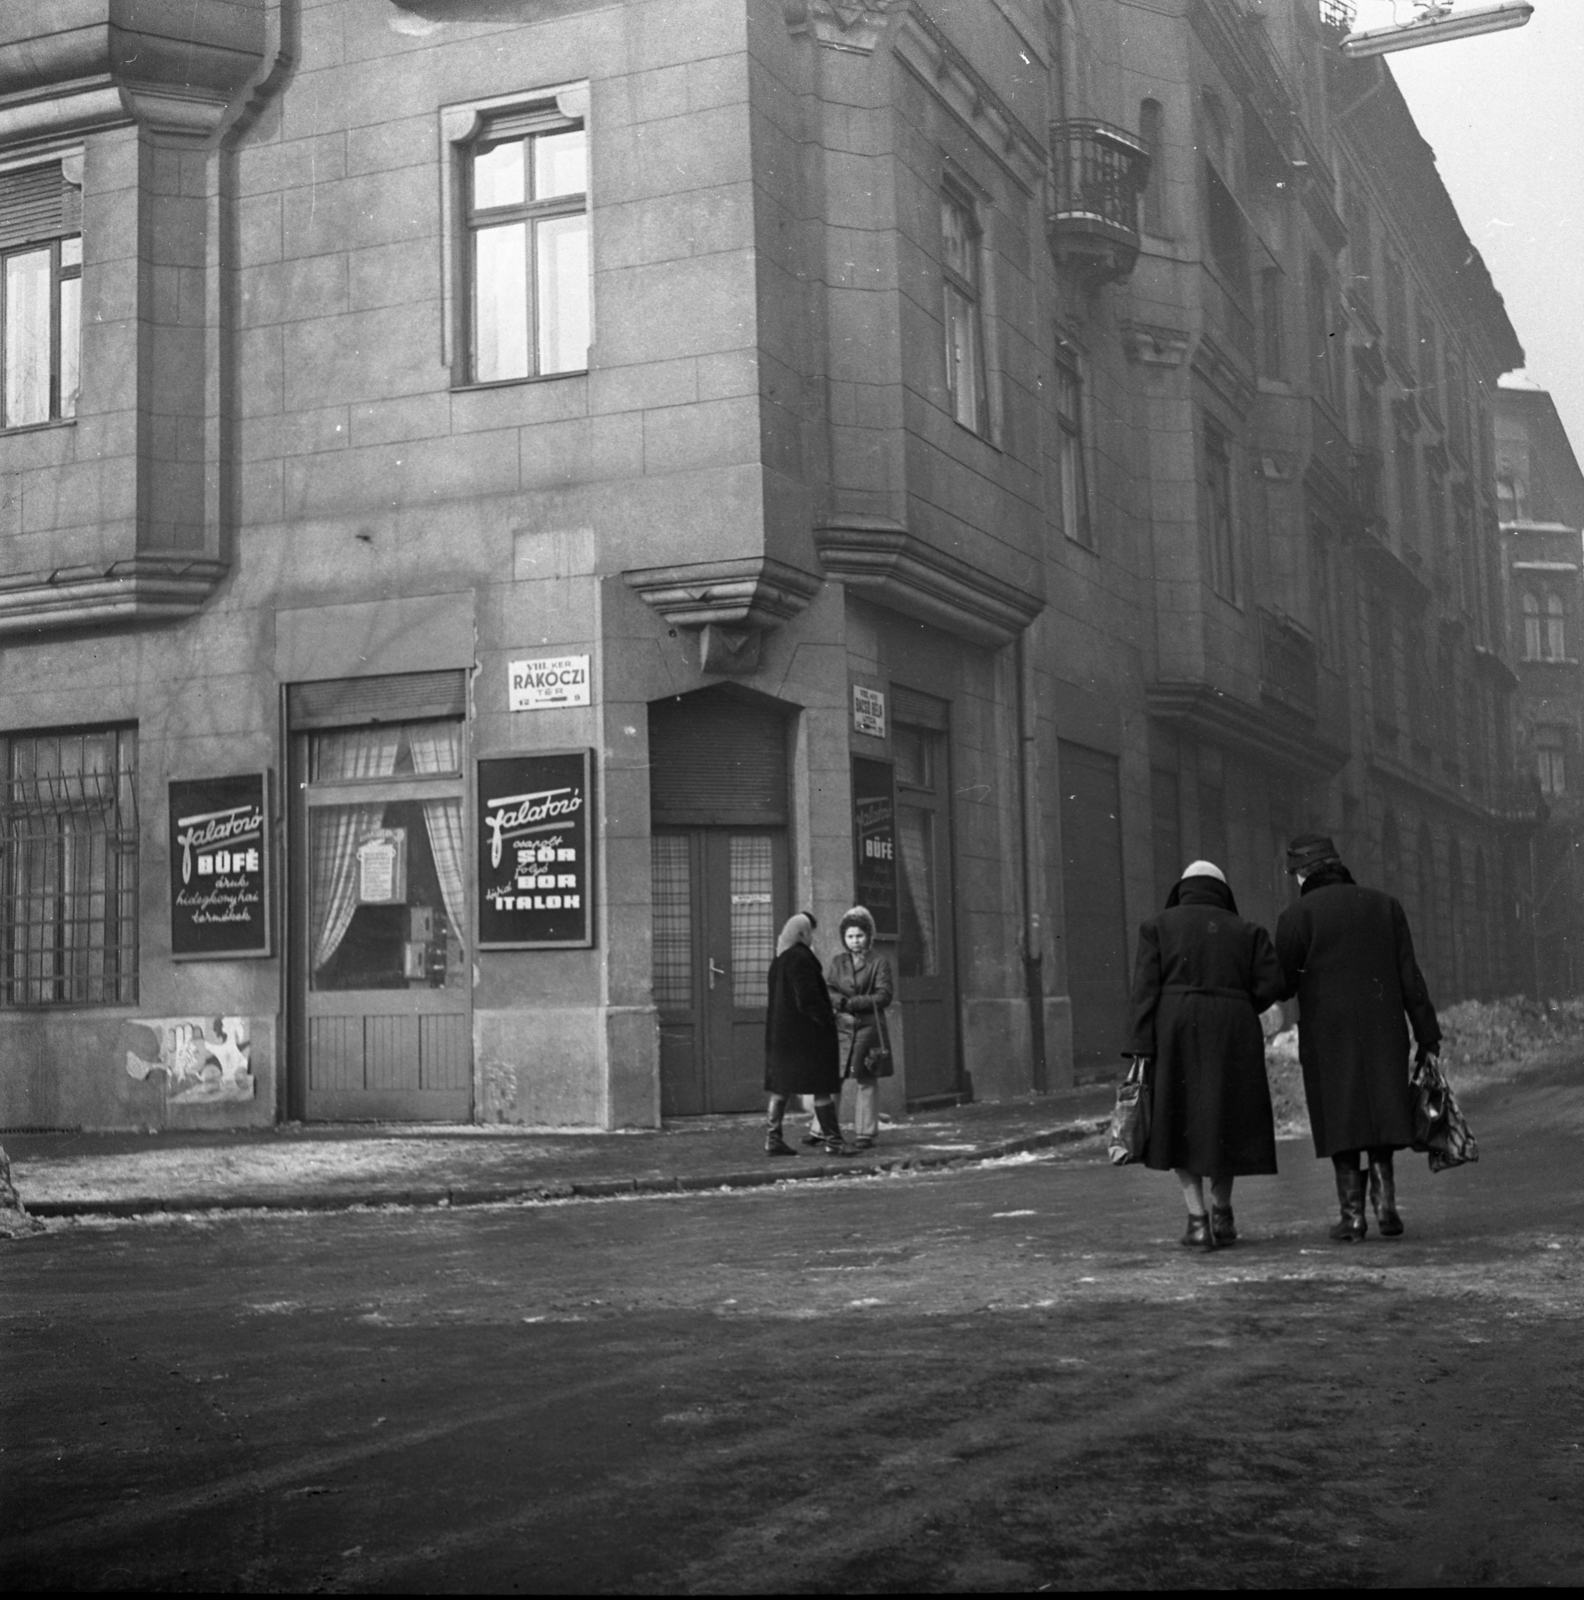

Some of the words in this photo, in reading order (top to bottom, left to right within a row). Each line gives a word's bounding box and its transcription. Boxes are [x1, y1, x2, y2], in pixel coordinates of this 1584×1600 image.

[514, 669, 585, 690] RÁKÓCZI
[537, 687, 563, 696] TÉR
[517, 845, 576, 863] SÖR
[865, 836, 893, 860] BÜFÉ
[198, 848, 259, 875] BÜFÉ
[514, 861, 549, 880] folyó
[517, 874, 576, 889] BOR
[495, 895, 580, 910] ITALOK
